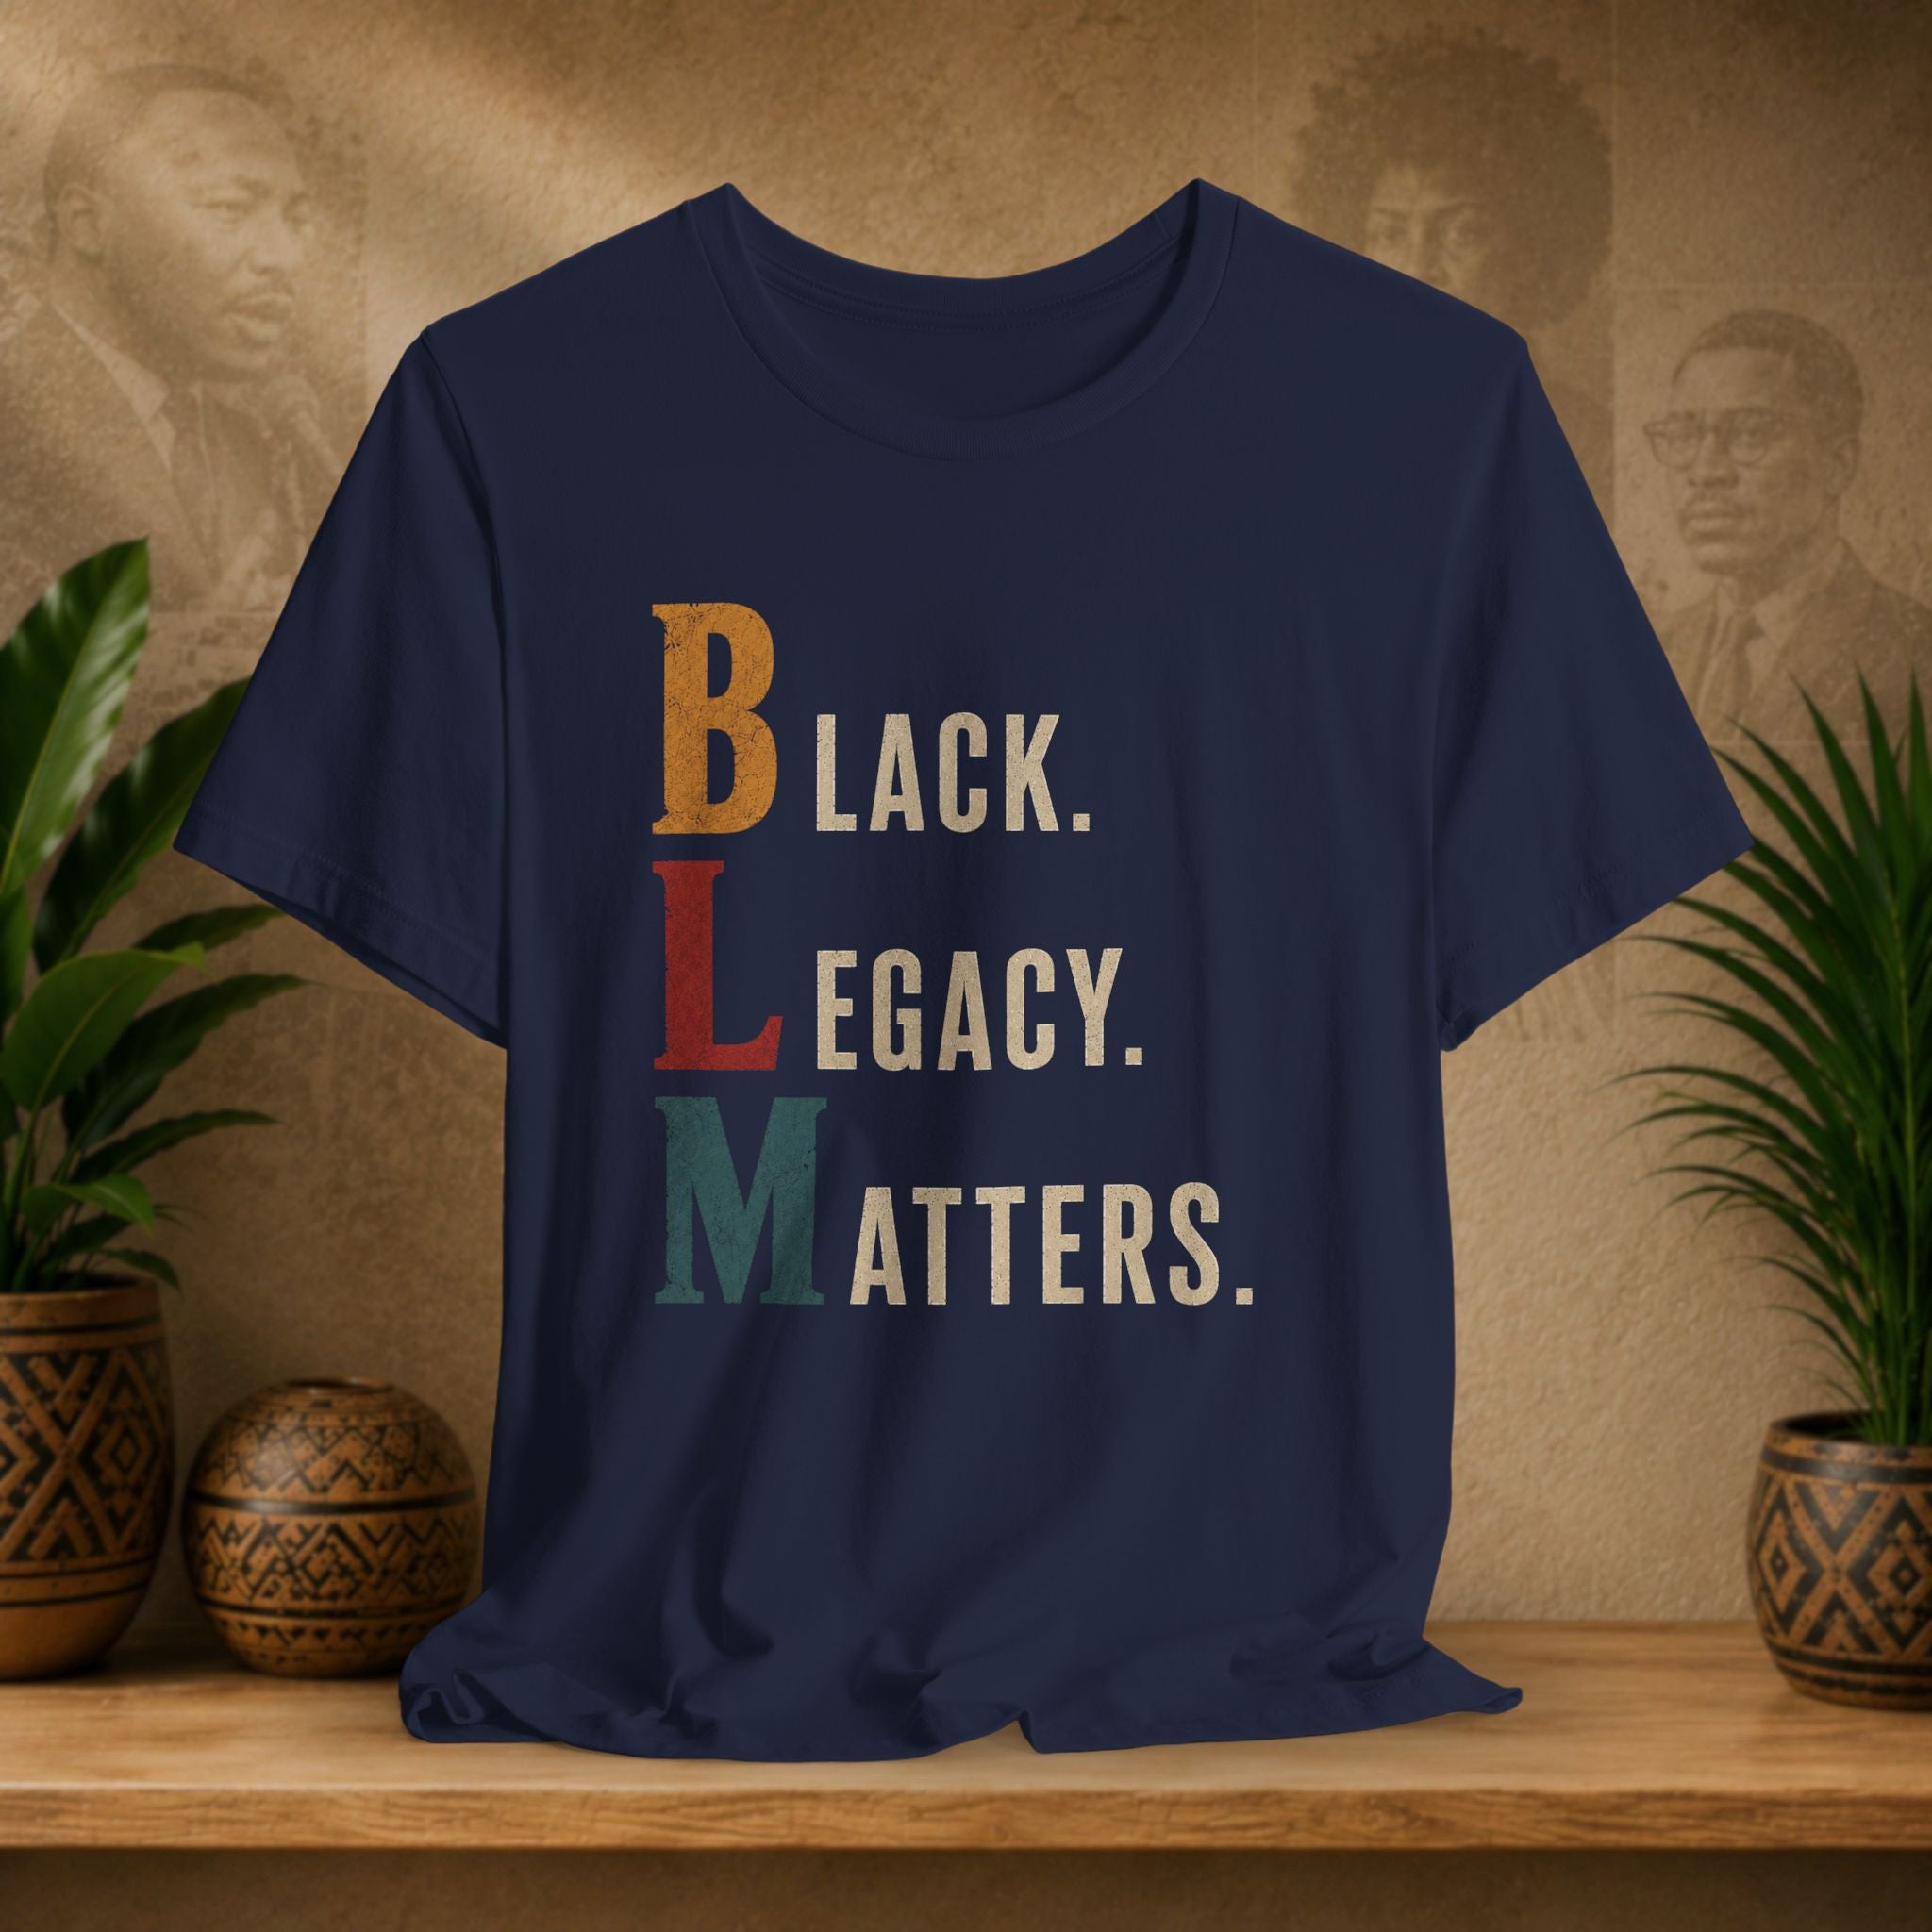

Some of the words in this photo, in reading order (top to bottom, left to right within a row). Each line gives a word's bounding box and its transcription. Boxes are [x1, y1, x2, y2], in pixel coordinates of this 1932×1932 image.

[651, 602, 1091, 835] BLACK.
[652, 860, 1143, 1072] LEGACY.
[653, 1096, 1254, 1306] MATTERS.
